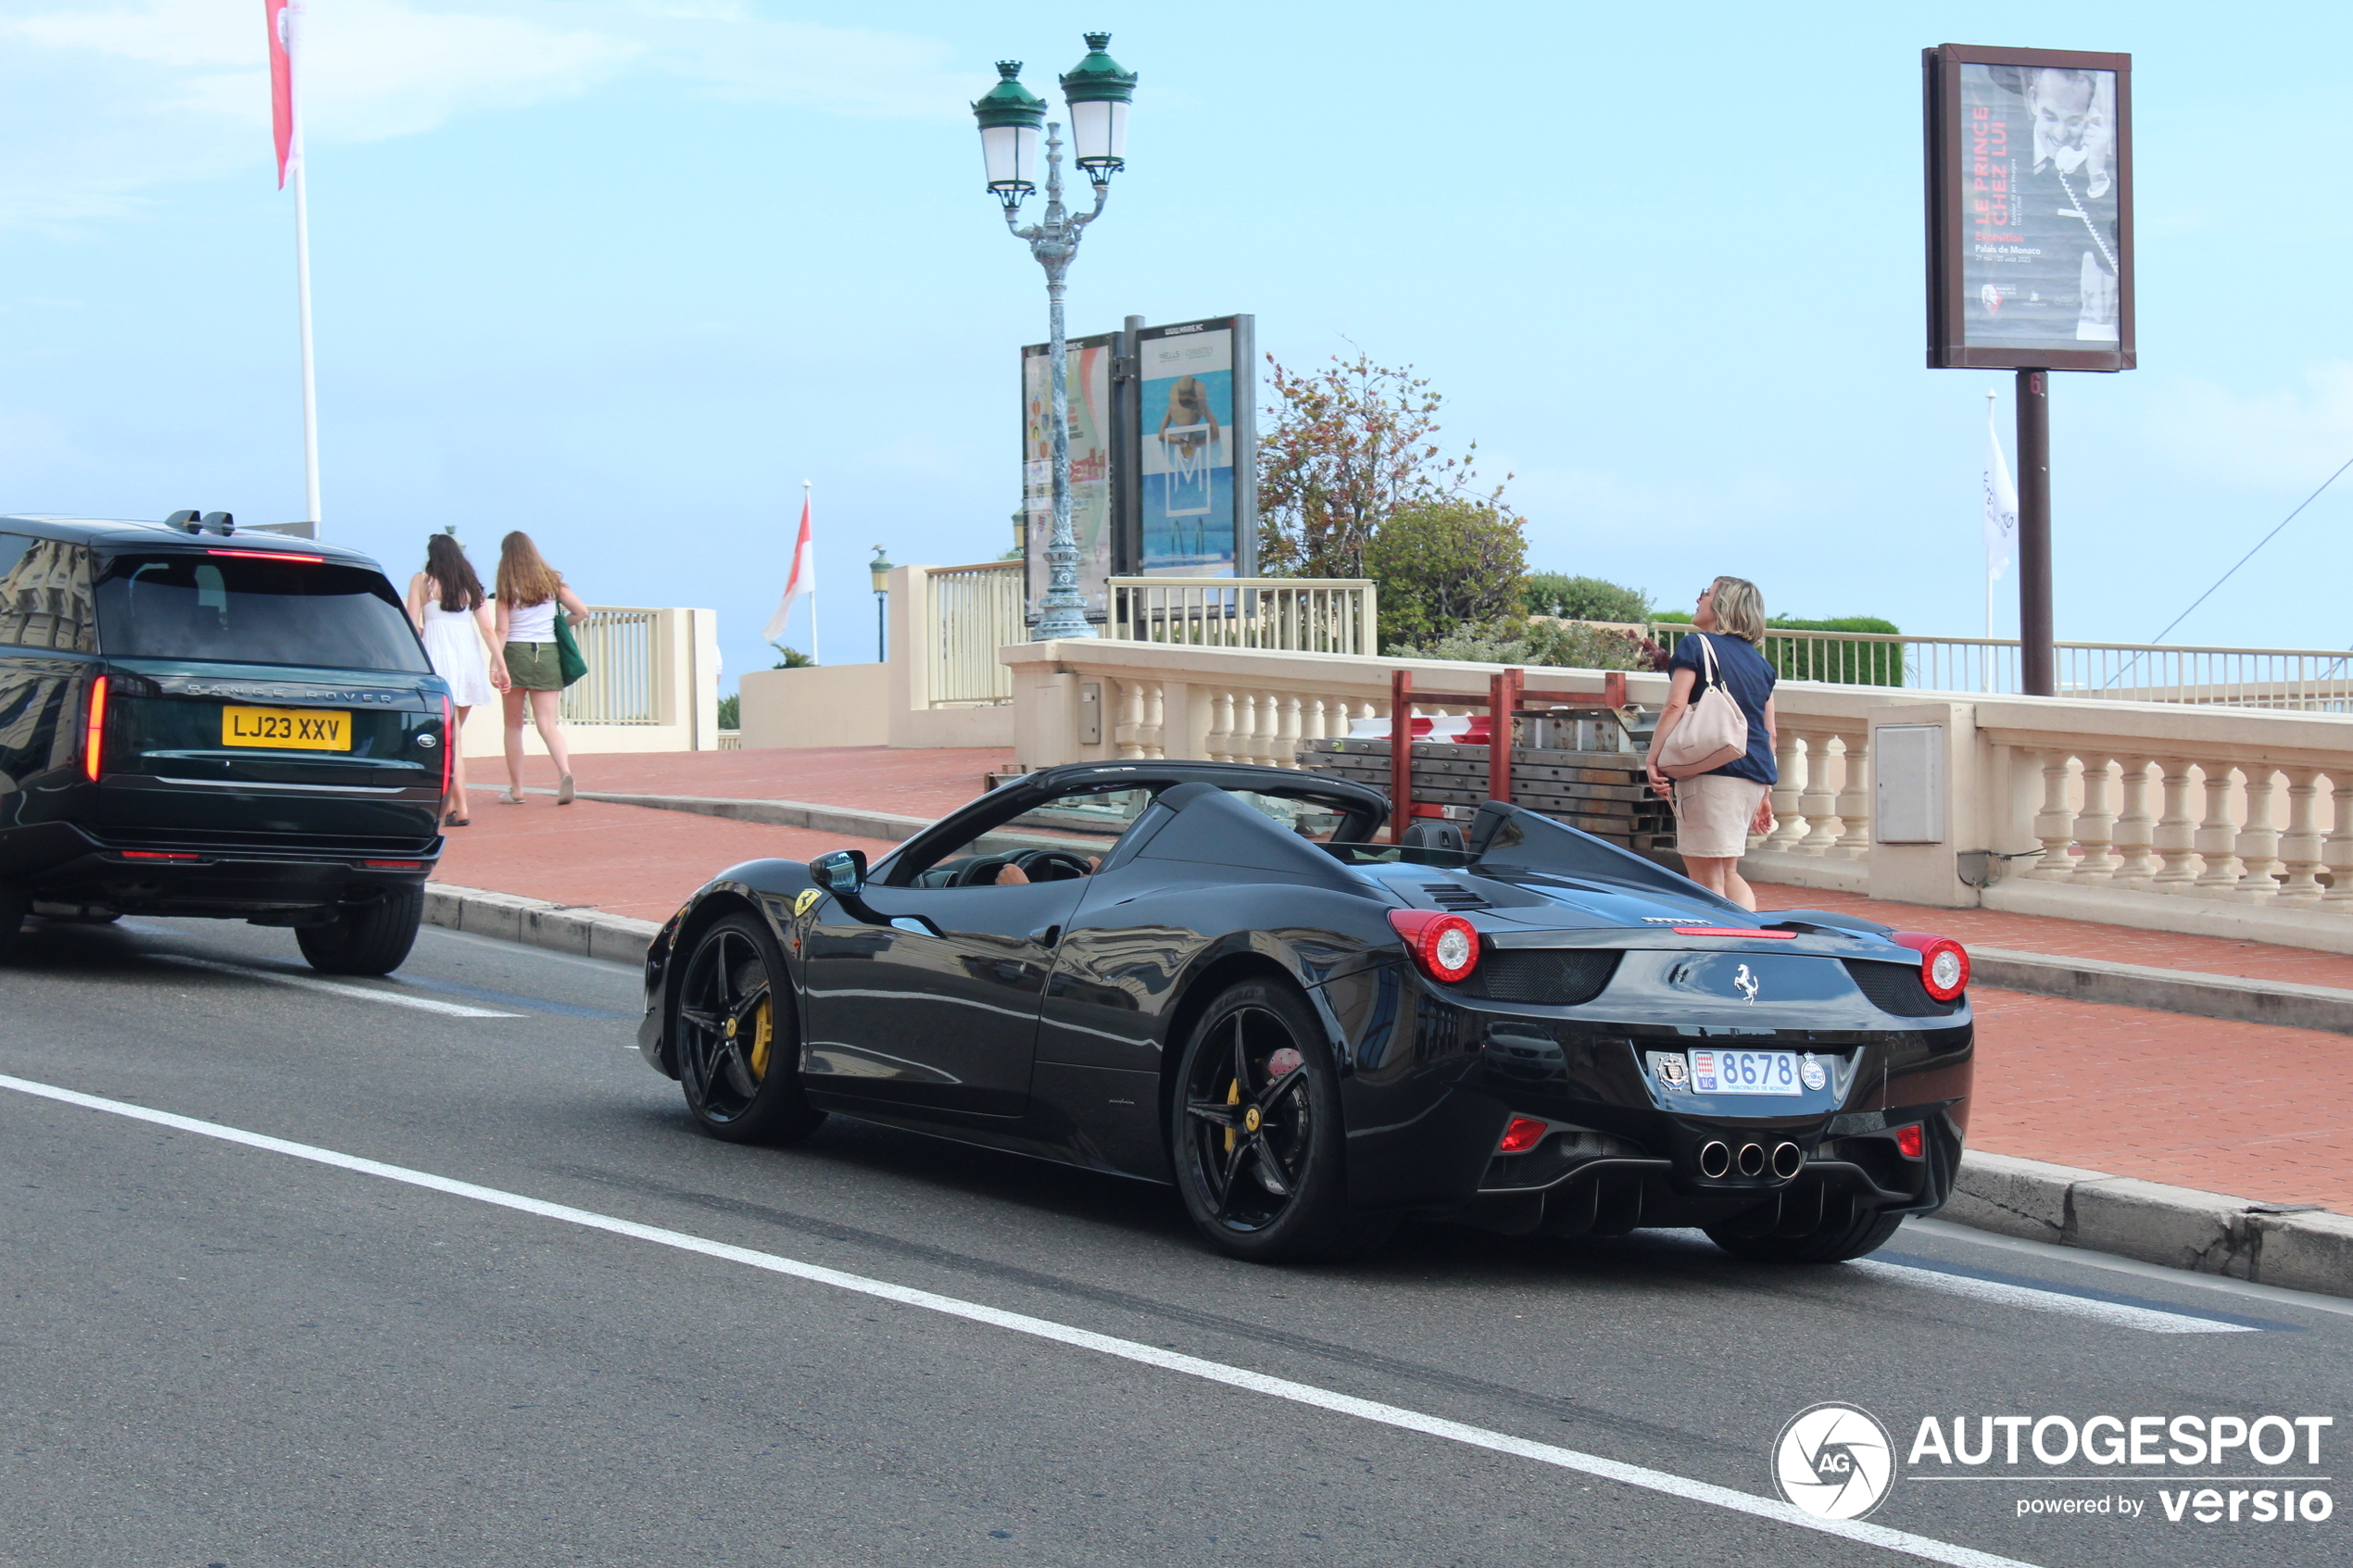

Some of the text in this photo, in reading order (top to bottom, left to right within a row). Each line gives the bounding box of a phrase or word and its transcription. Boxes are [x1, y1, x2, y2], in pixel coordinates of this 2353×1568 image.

[1972, 107, 1990, 224] LE PRINCE
[1991, 122, 2008, 226] CHEZ LUI
[2010, 184, 2018, 194] en
[1975, 231, 2025, 243] Exposition
[1975, 245, 2042, 255] Palais de Monaco
[2030, 372, 2042, 394] 6
[187, 684, 393, 704] RANGE ROVER
[233, 715, 340, 742] LJ23 XXV
[1722, 1053, 1793, 1086] 8678
[1702, 1078, 1715, 1088] MC
